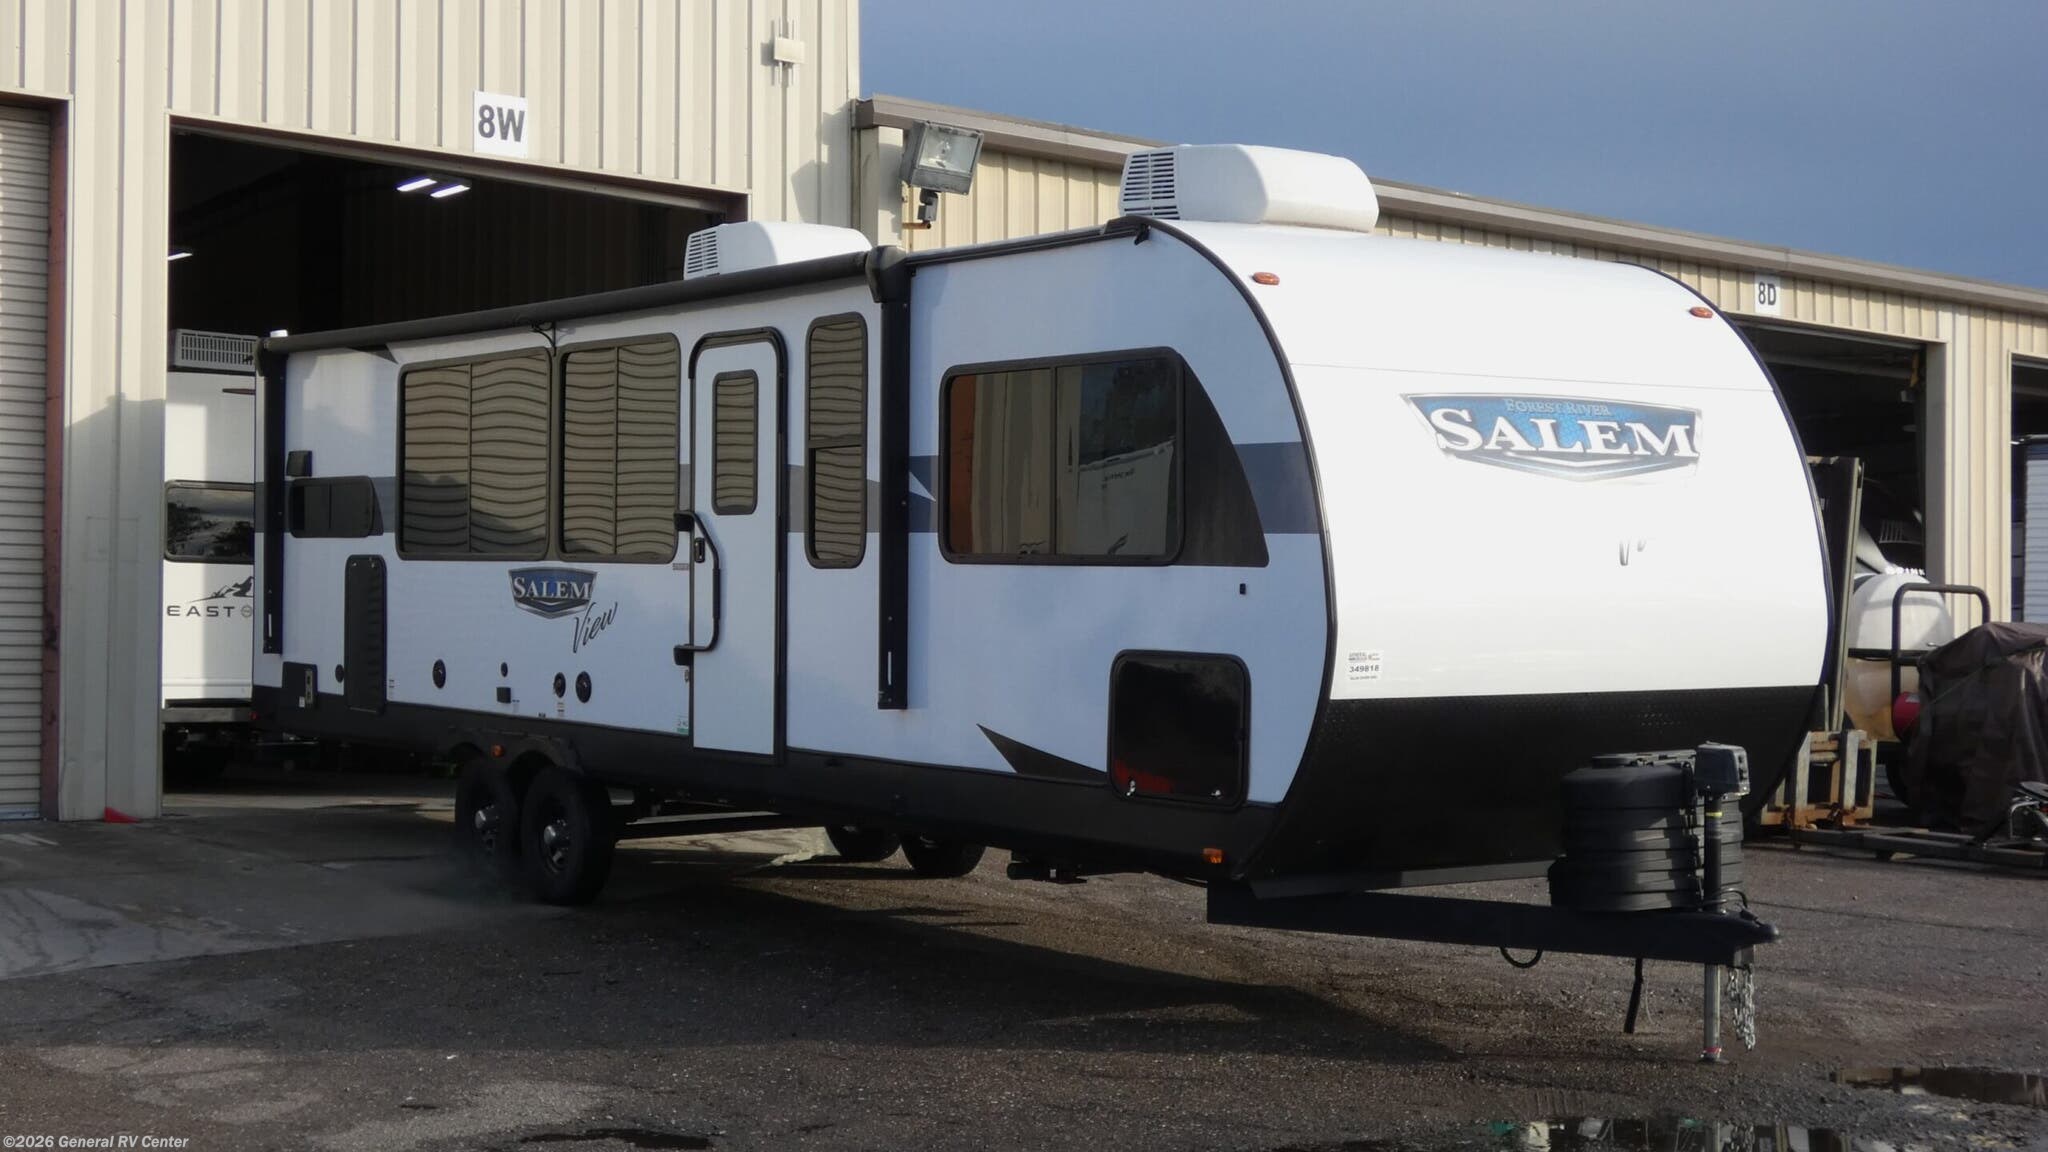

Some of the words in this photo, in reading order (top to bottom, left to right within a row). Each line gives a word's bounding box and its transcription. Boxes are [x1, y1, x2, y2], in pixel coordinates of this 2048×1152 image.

[478, 104, 525, 142] 8W
[1758, 281, 1777, 305] 8D
[1504, 398, 1563, 414] FOREST
[1566, 401, 1612, 417] RIVER
[1430, 407, 1700, 458] SALEM
[513, 576, 592, 599] SALEM
[572, 601, 618, 653] View
